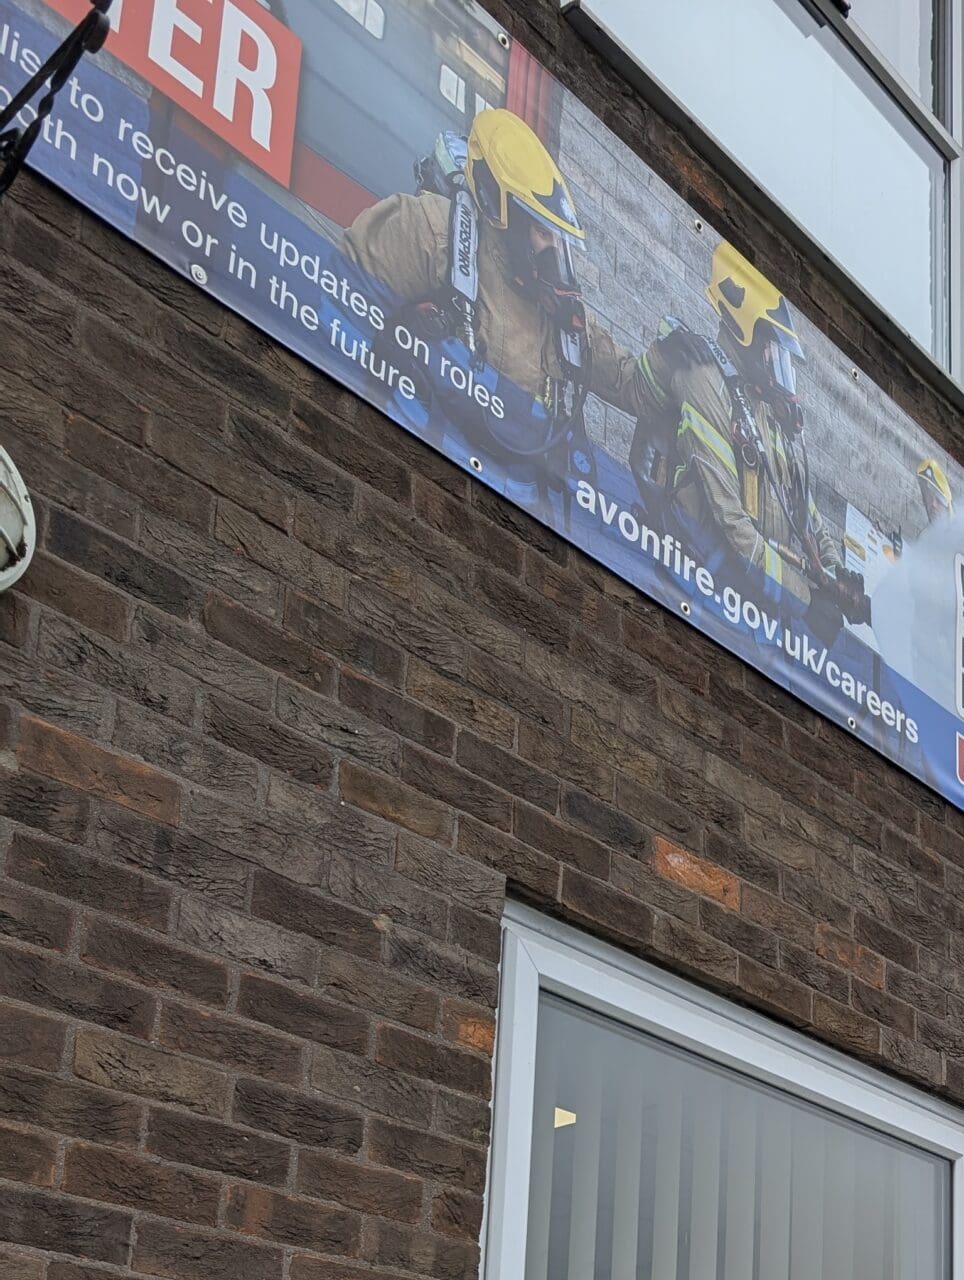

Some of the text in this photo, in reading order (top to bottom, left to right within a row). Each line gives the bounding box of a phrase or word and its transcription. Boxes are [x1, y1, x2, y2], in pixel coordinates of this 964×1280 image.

[0, 23, 505, 420] lis to receive updates on roles
[92, 152, 171, 224] now
[182, 220, 219, 257] or
[228, 244, 256, 289] in
[268, 275, 319, 331] the
[329, 318, 416, 400] future
[575, 479, 919, 744] avonfire.gov.uk/careers
